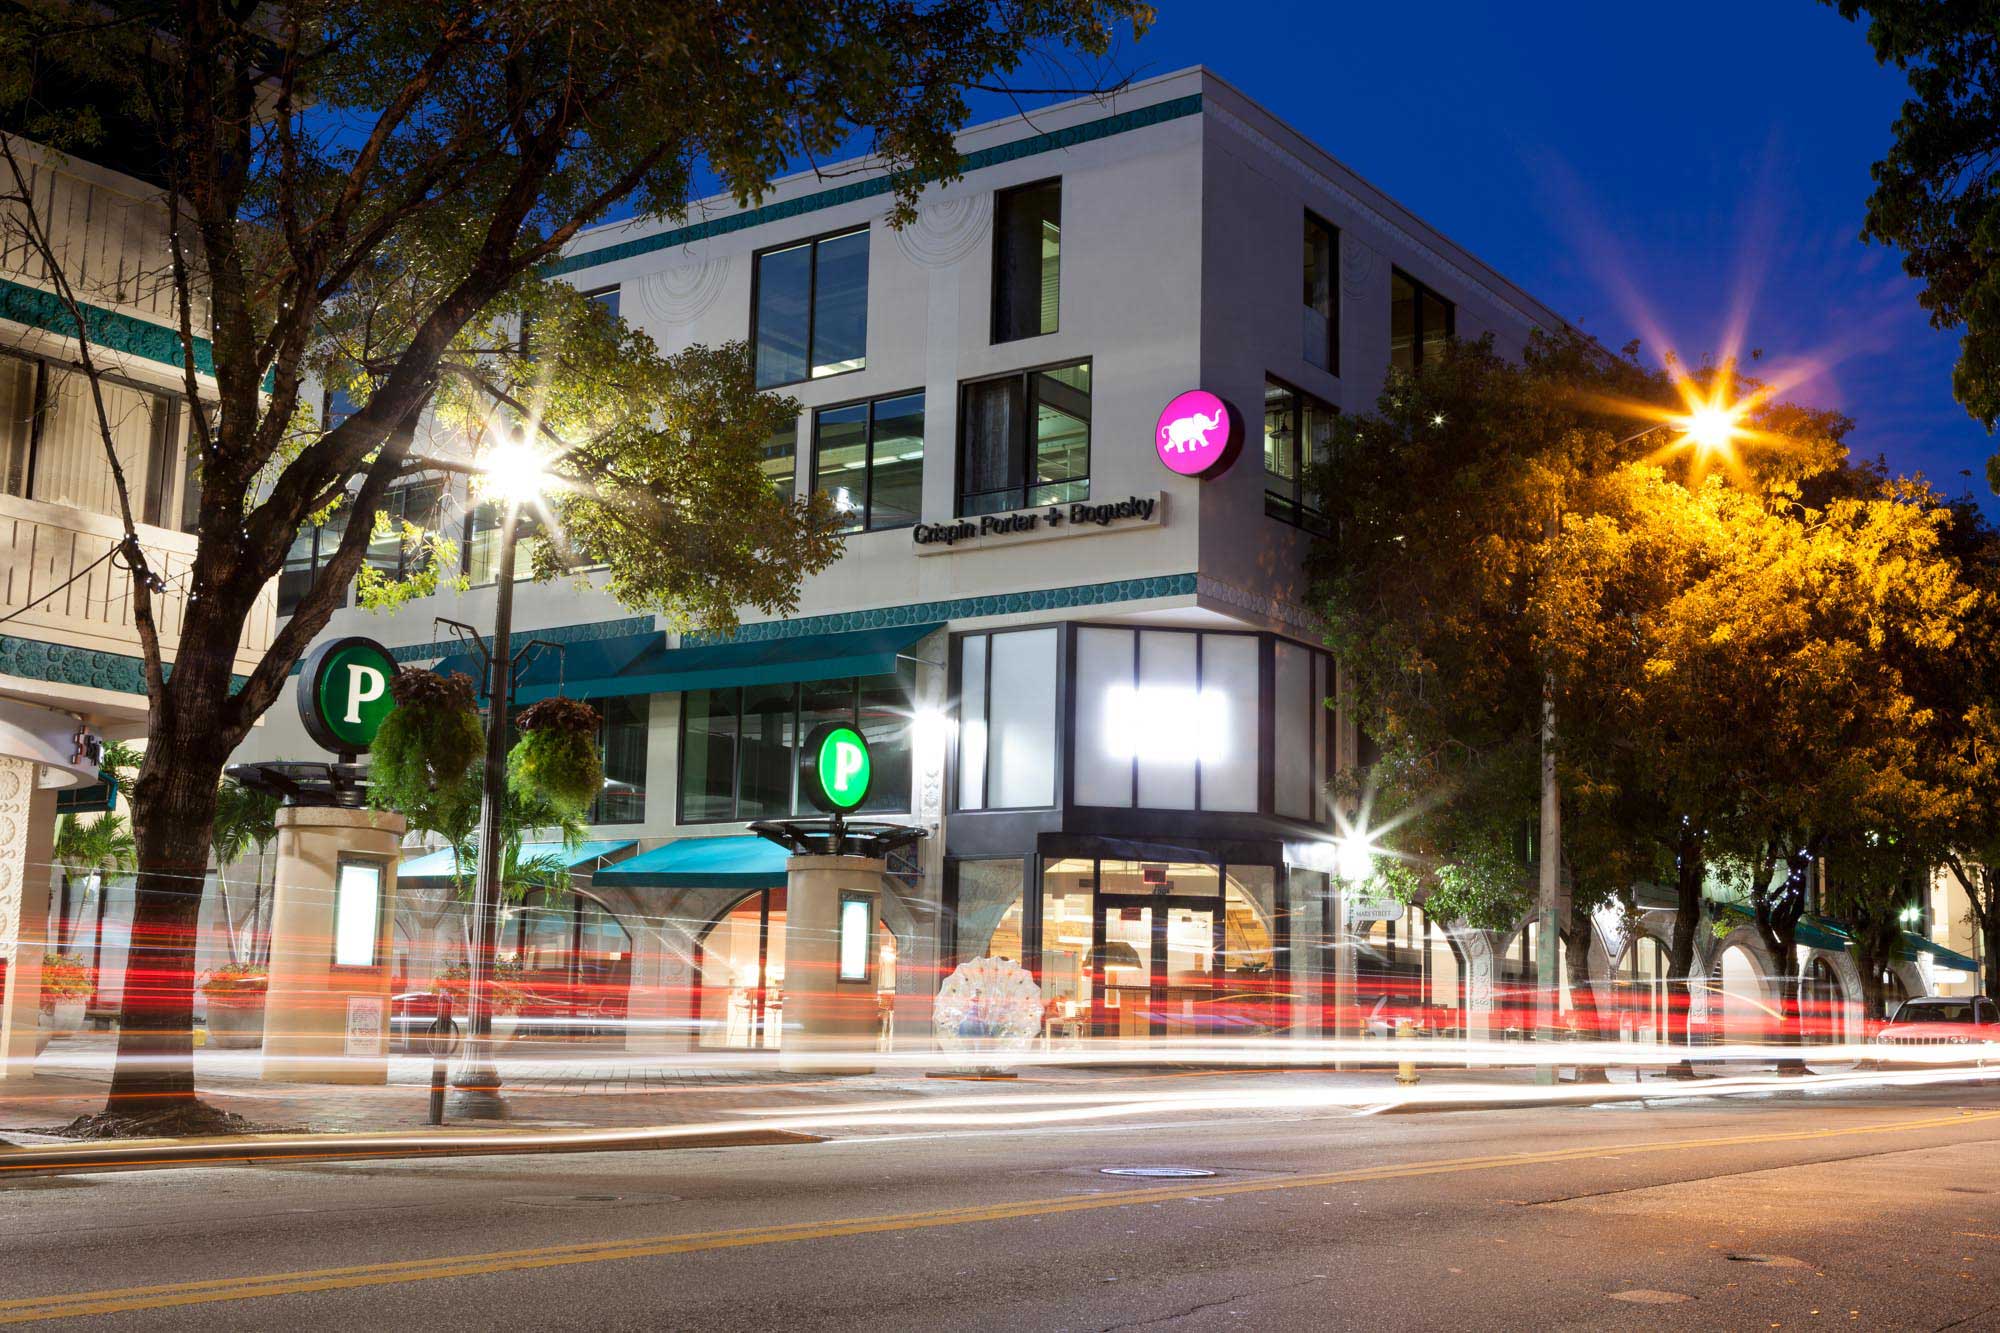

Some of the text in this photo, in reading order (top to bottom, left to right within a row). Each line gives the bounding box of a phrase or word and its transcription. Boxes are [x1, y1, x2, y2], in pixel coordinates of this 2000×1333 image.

[913, 496, 1154, 545] Crispin Porter + Bogusky
[343, 664, 385, 723] P
[834, 742, 863, 791] P
